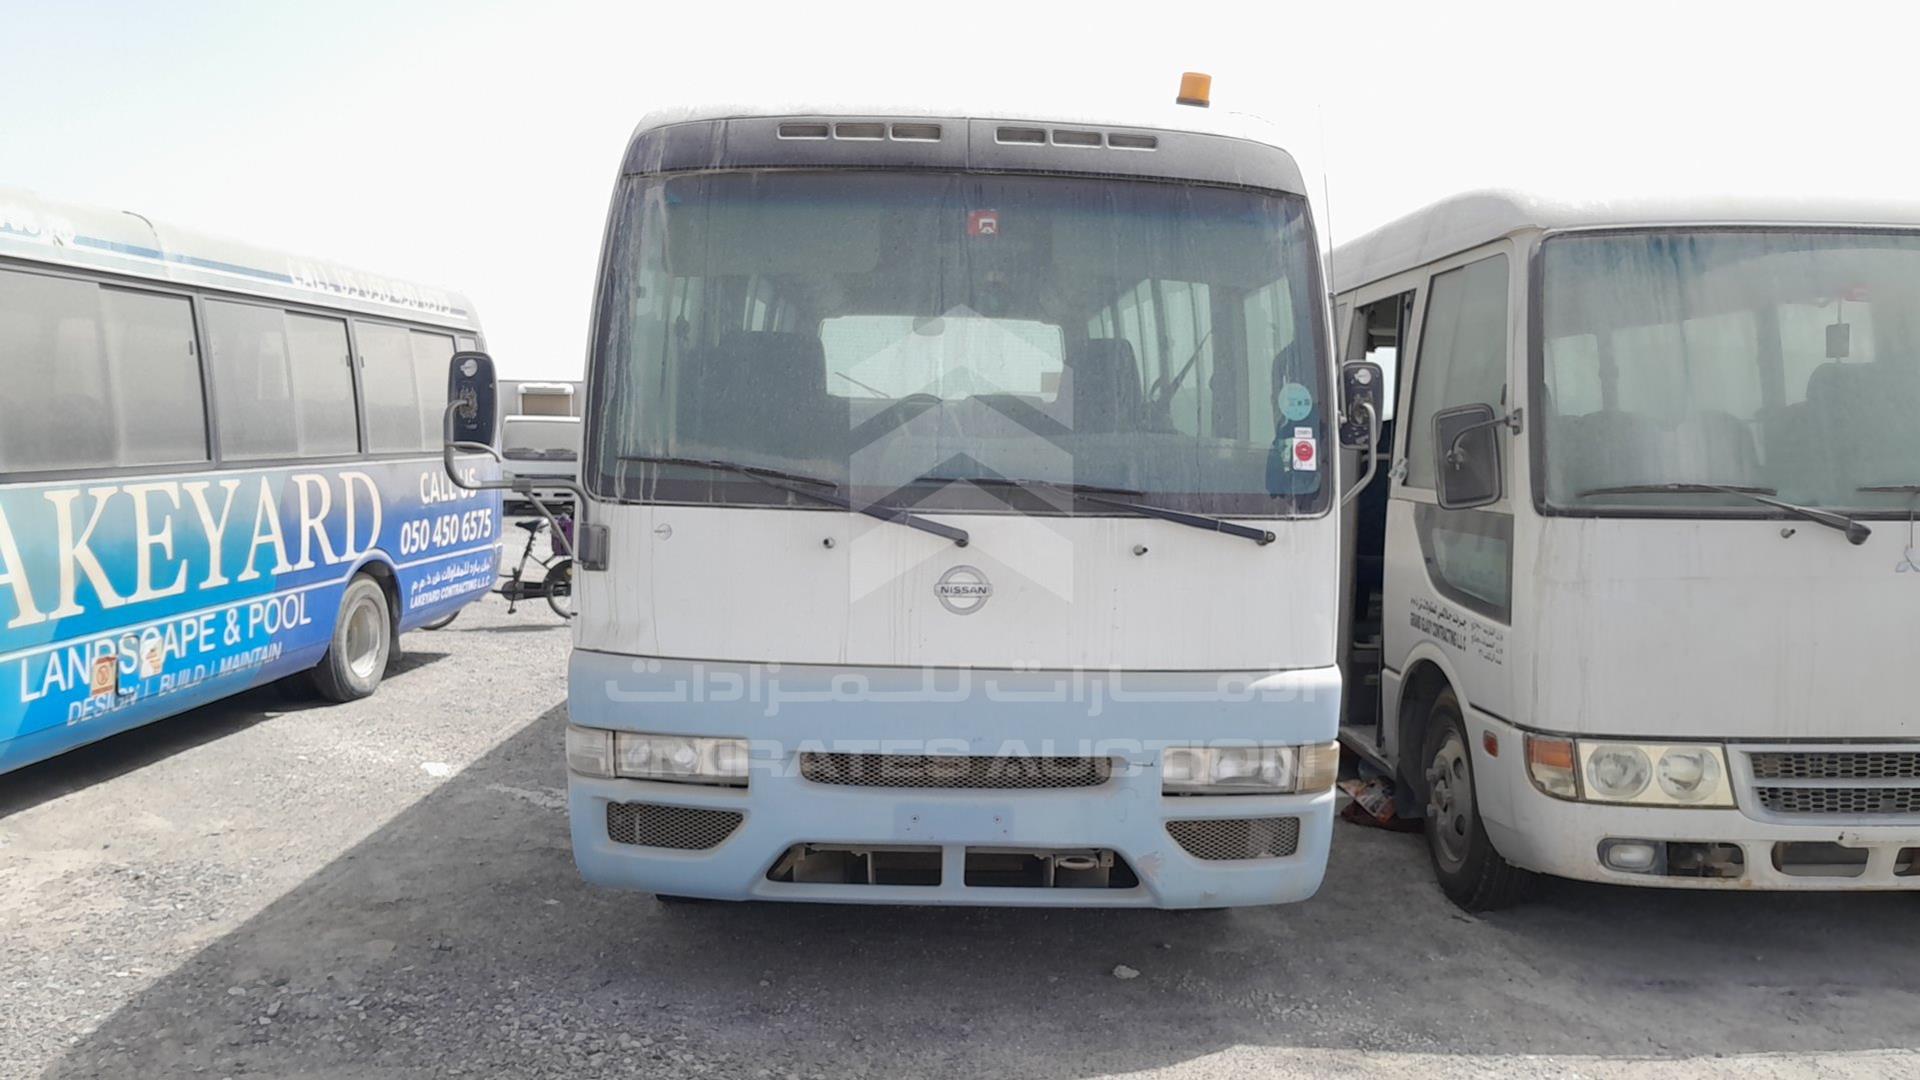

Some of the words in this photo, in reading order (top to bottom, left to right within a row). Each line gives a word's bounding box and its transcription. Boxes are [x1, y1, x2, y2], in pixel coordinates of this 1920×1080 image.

[420, 471, 457, 505] CALL
[460, 467, 477, 499] US
[401, 518, 430, 556] 050
[432, 513, 459, 548] 450
[462, 508, 492, 542] 6575
[410, 588, 440, 610] LAKEYARD
[440, 578, 477, 600] CONTRACTING
[940, 586, 987, 594] NISSAN
[20, 613, 215, 703] LANSAPE
[223, 607, 241, 646] &
[249, 592, 312, 638] POOL
[158, 664, 206, 696] BUILD
[220, 641, 283, 677] MAINTAIN
